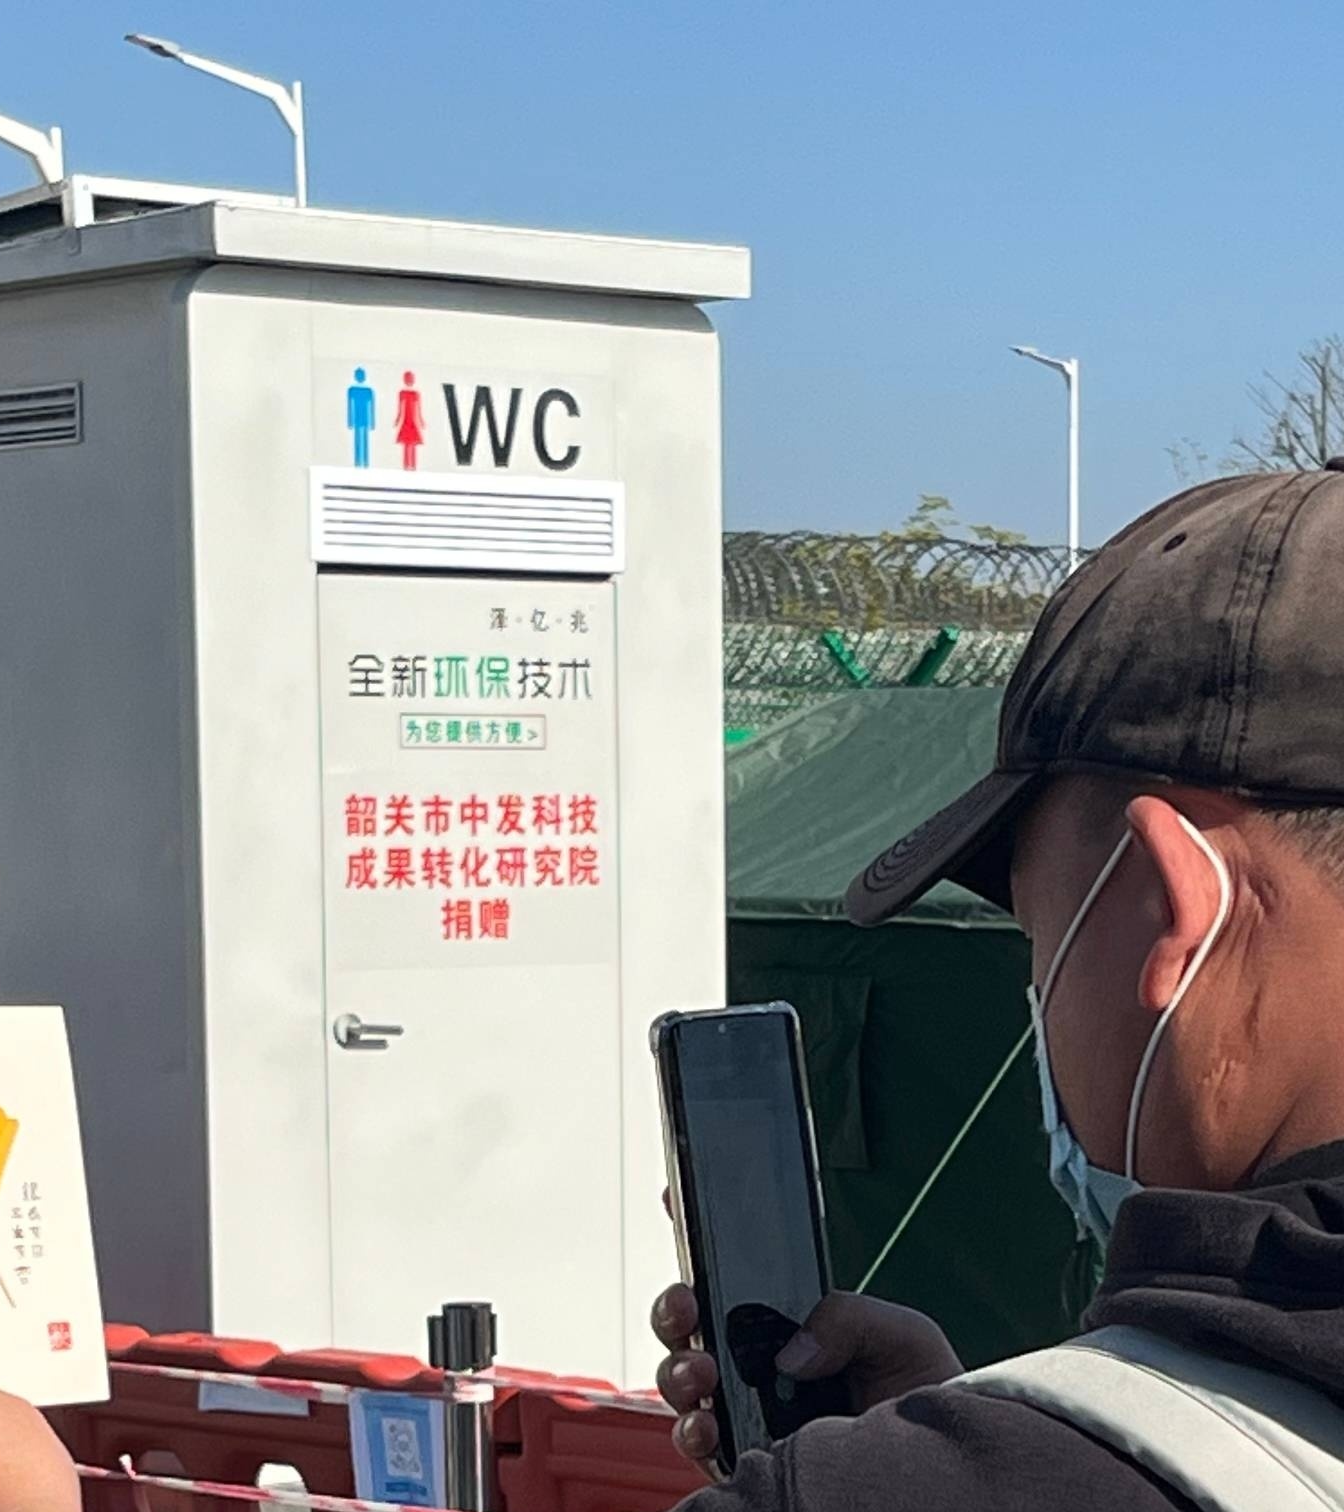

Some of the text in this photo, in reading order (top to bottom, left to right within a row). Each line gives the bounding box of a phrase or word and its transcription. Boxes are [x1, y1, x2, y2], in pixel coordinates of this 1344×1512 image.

[442, 382, 582, 472] WC
[347, 652, 595, 700] 全新环保技术
[344, 793, 600, 839] 韶关市中发科技
[344, 845, 601, 890] 成果转化研究院
[440, 898, 511, 941] 捐赠
